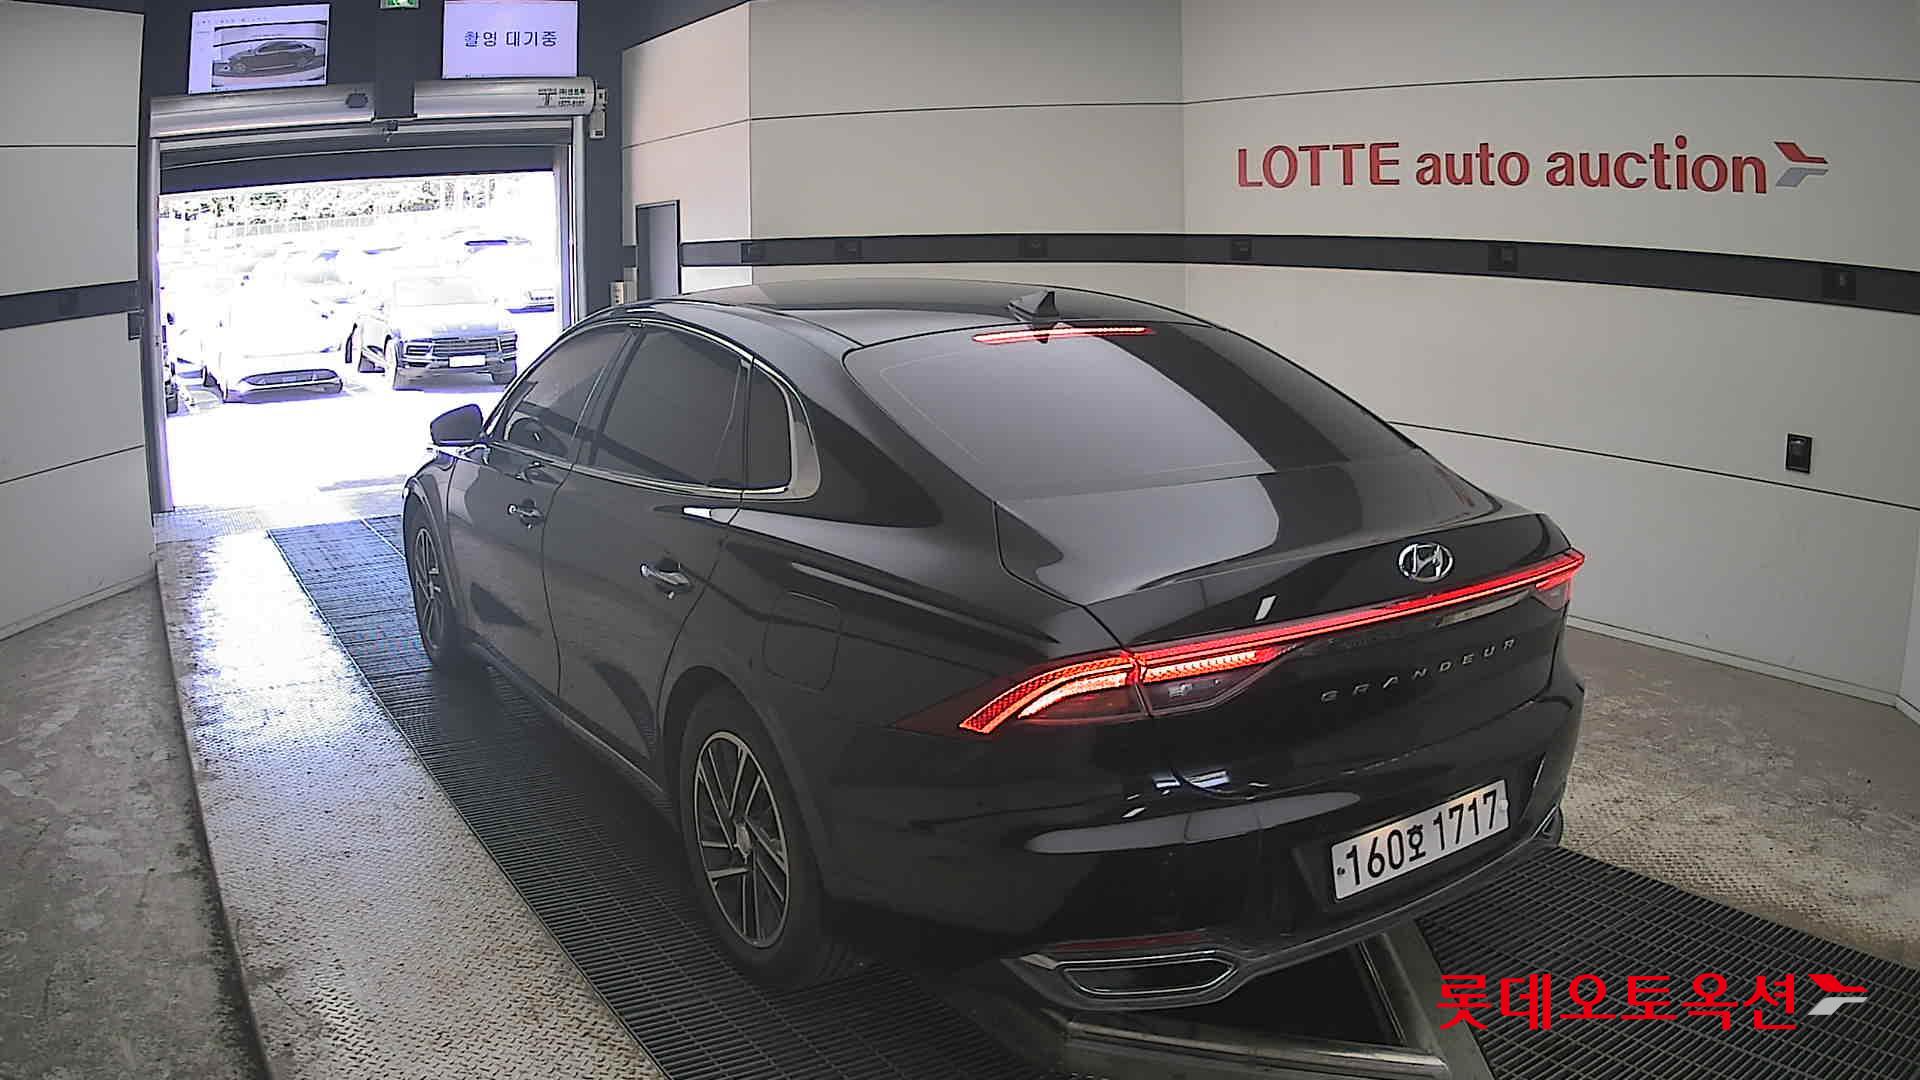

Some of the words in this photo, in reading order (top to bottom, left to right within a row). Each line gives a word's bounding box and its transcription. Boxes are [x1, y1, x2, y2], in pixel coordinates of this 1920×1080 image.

[505, 31, 558, 48] 대기중
[1237, 142, 1401, 189] LOTTE
[1415, 142, 1530, 187] auto
[1545, 135, 1768, 195] auction
[1320, 638, 1515, 703] GRANDEUR
[1346, 824, 1427, 886] 160호
[1433, 789, 1498, 851] 1717
